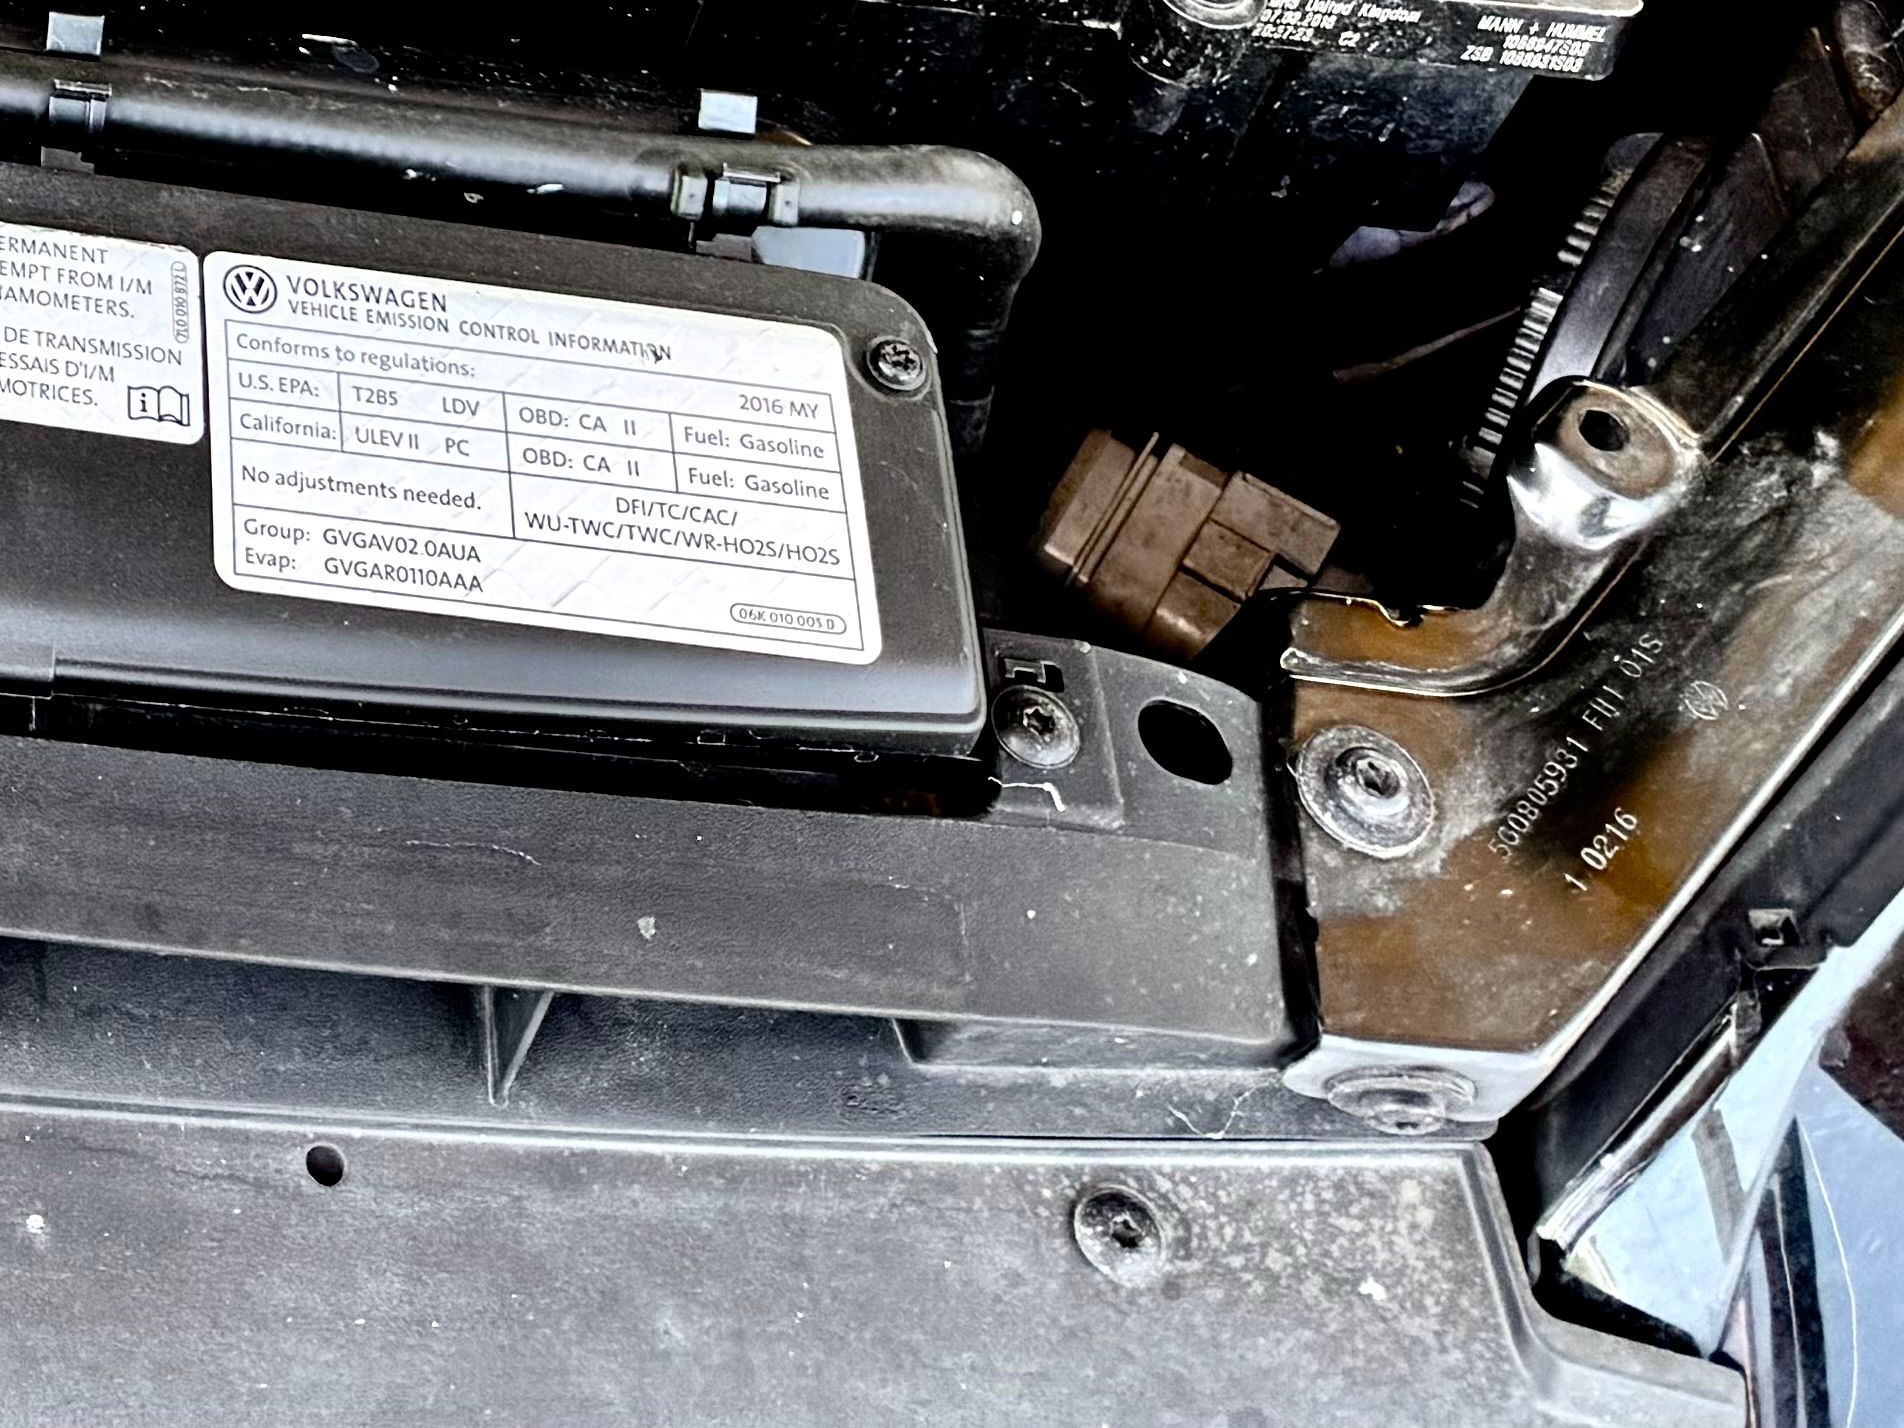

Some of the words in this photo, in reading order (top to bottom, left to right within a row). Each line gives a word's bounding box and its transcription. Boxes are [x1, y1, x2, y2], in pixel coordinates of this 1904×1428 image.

[1477, 15, 1525, 37] MANN
[1545, 22, 1607, 43] HUMMEL
[56, 266, 113, 291] FROM
[285, 274, 447, 313] VOLKSWAGEN
[287, 298, 359, 323] VEHICLE
[364, 307, 450, 334] EMISSION
[458, 319, 540, 345] CONTROL
[3, 325, 30, 346] DE
[33, 329, 182, 367] TRANSMISSION
[235, 332, 331, 360] Conforms
[333, 344, 356, 363] to
[359, 350, 476, 378] regulations:
[237, 371, 274, 392] U.S.
[277, 375, 320, 398] EPA:
[351, 384, 399, 407] T2B5
[441, 395, 481, 417] LDV
[517, 405, 569, 428] OBD:
[577, 412, 608, 433] CA
[622, 418, 637, 436] II
[683, 425, 730, 448] Fuel:
[738, 432, 825, 459] Gasoline
[738, 393, 784, 415] 2016
[788, 399, 819, 420] MY
[238, 411, 337, 441] California:
[354, 425, 404, 448] ULEV
[444, 436, 470, 457] PC
[521, 446, 574, 470] OBD:
[582, 453, 612, 474] CA
[626, 459, 640, 478] II
[687, 466, 735, 489] Fuel:
[743, 473, 830, 501] Gasoline
[241, 463, 270, 484] No
[274, 470, 398, 500] adjustments
[402, 487, 482, 511] needed.
[615, 495, 738, 527] DFI/TC/CAC/
[242, 517, 311, 545] Group:
[244, 546, 296, 572] Evap:
